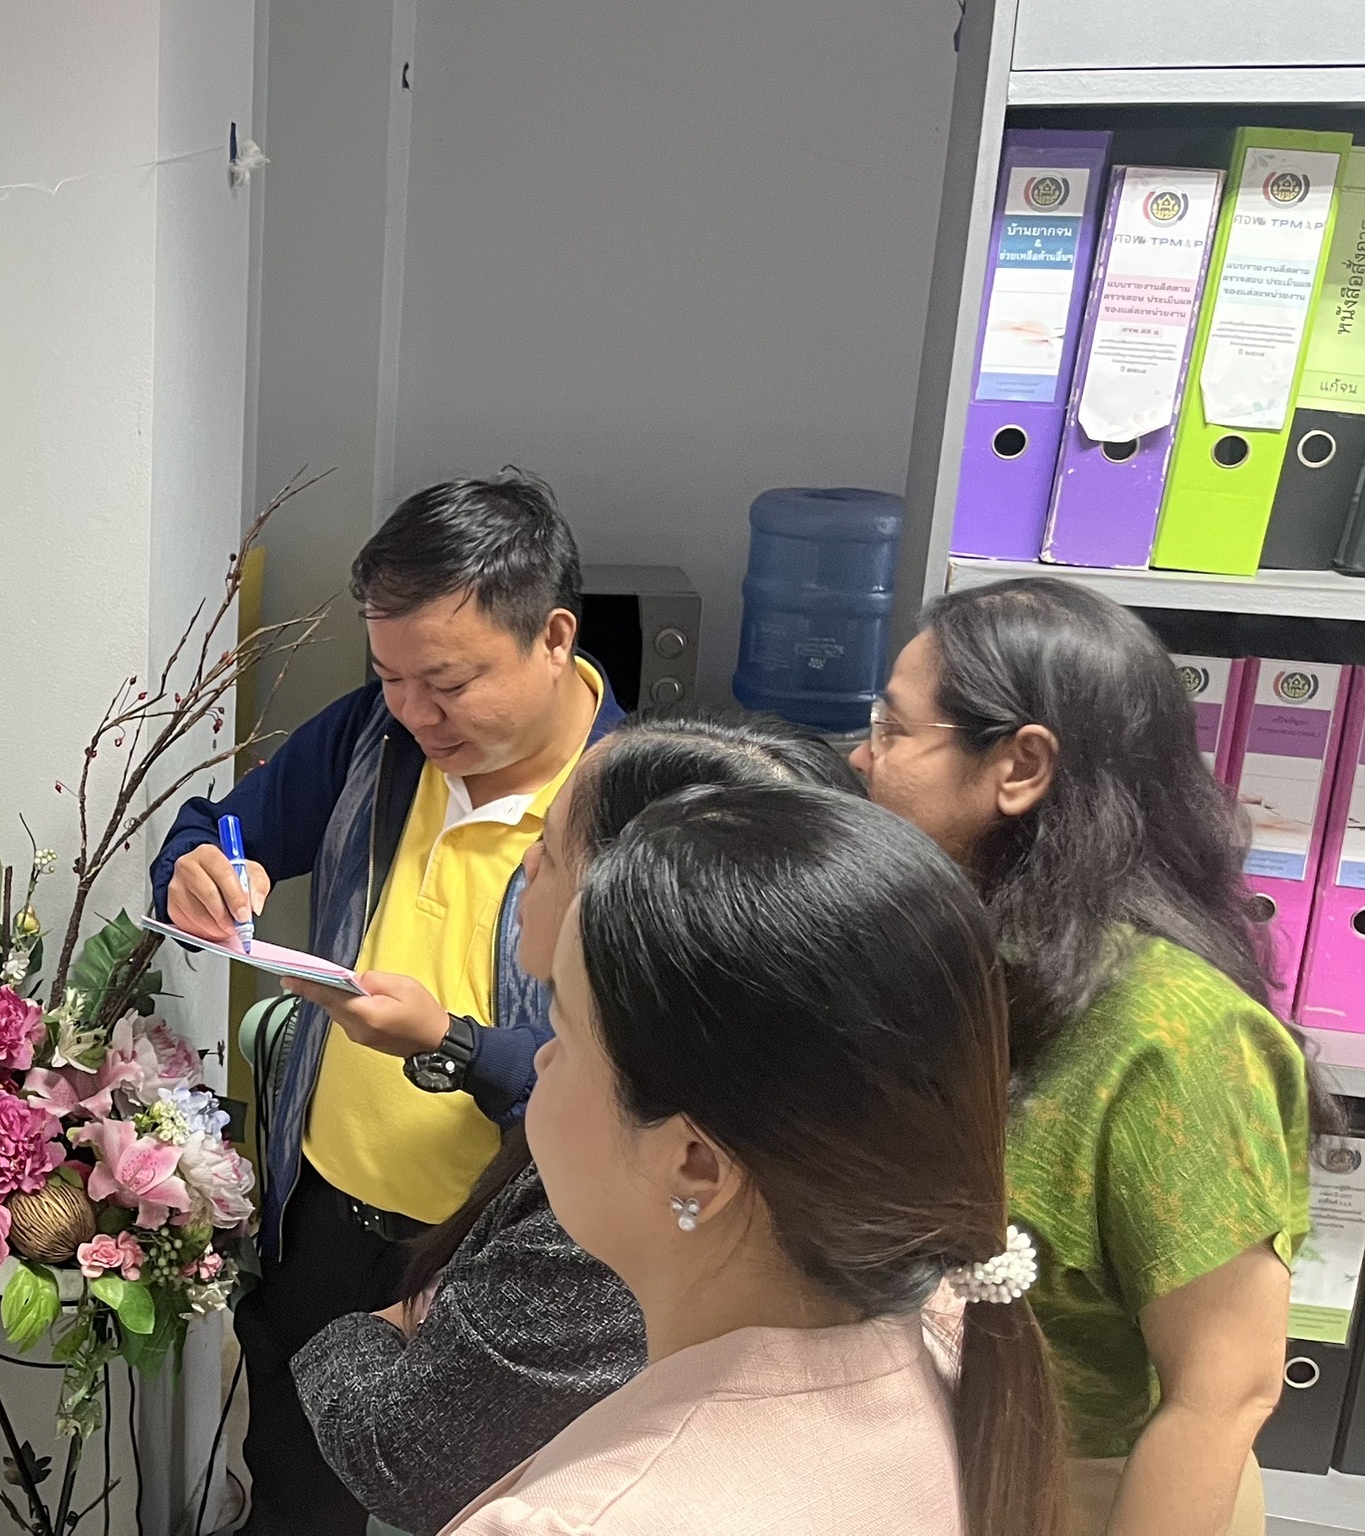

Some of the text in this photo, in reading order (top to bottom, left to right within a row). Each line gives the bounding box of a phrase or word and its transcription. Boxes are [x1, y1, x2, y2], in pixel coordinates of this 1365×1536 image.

[1007, 223, 1073, 237] บ้านยากจน
[1034, 239, 1042, 248] &
